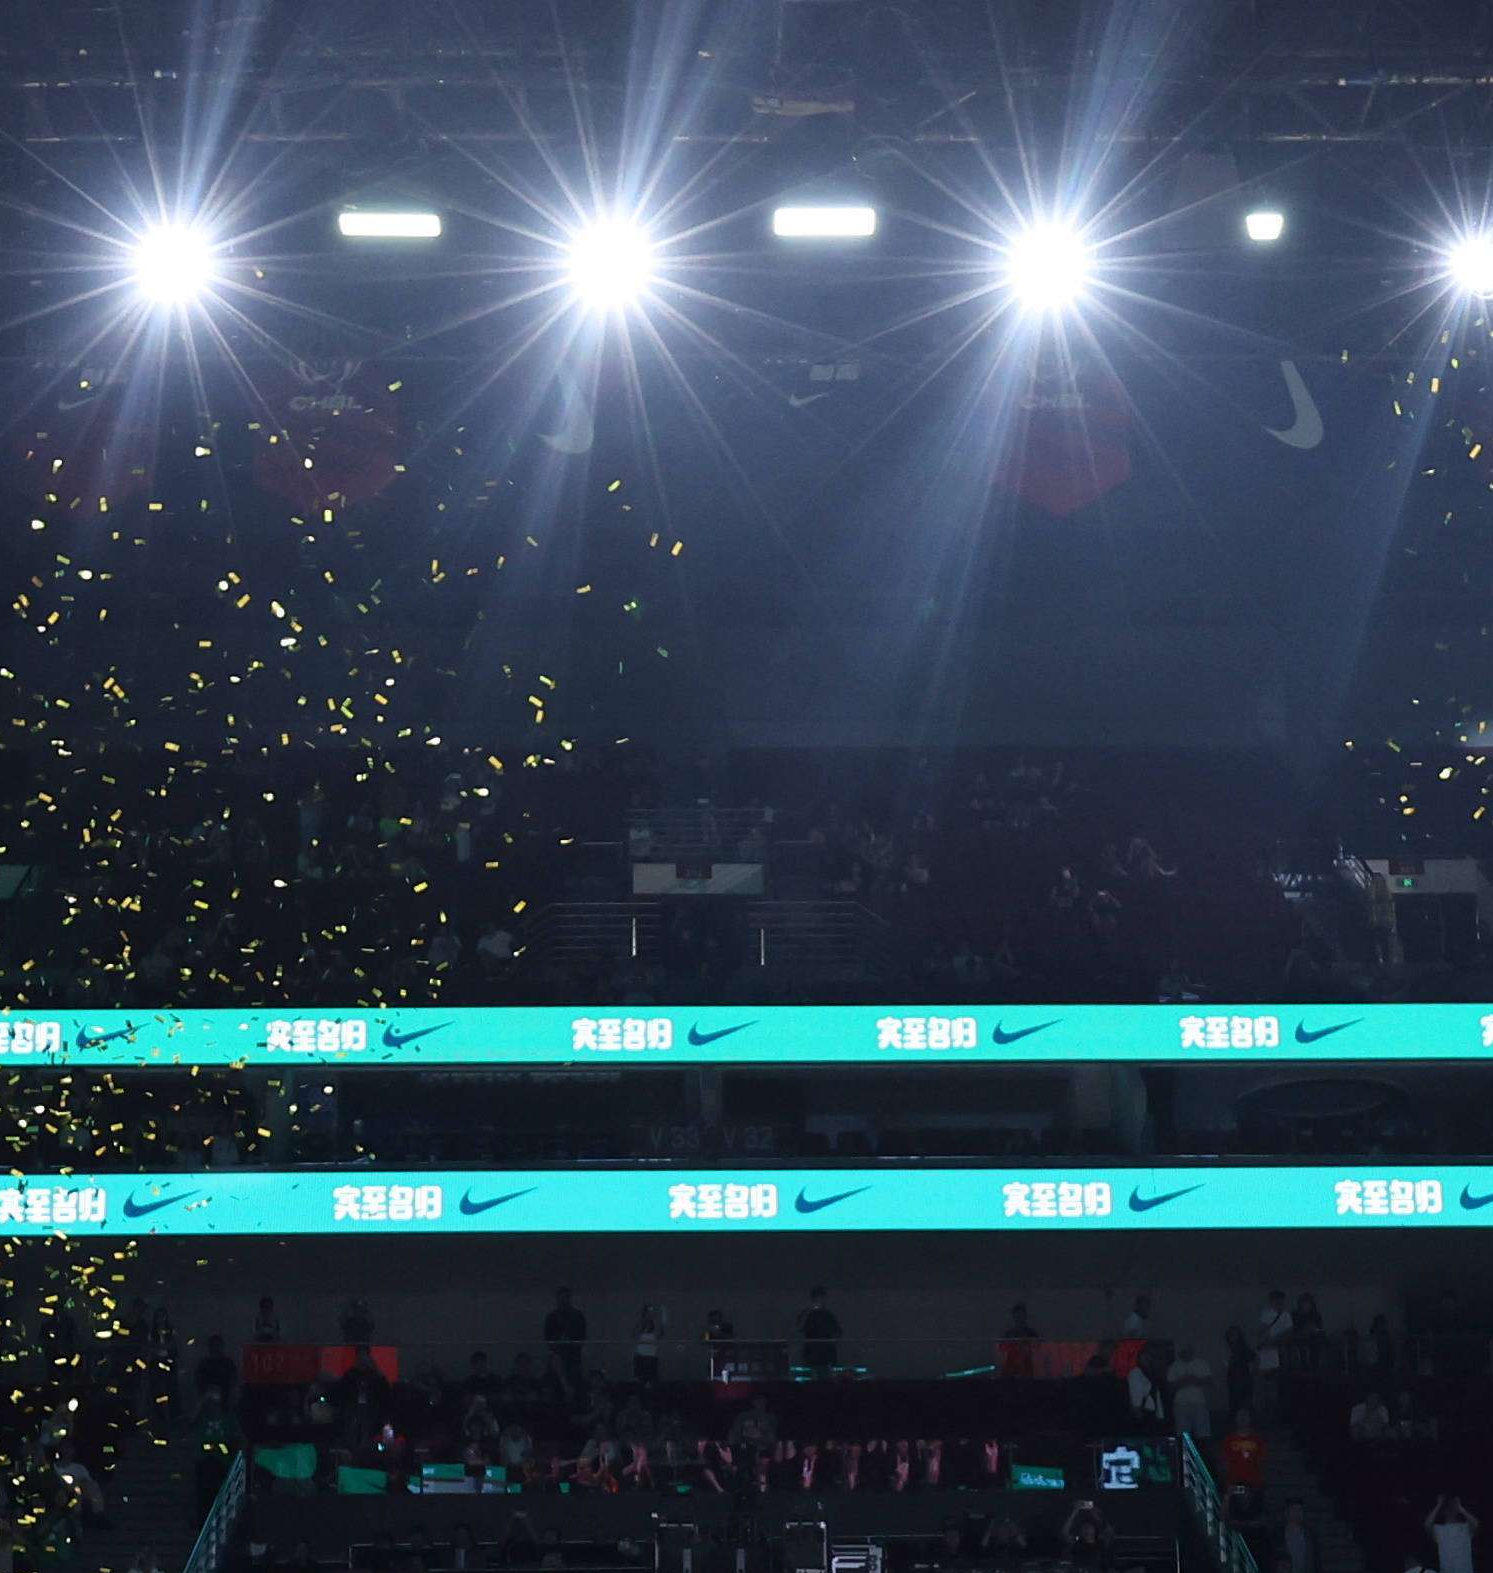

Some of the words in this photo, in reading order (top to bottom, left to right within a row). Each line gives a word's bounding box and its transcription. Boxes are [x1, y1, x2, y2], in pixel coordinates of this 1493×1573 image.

[572, 1017, 673, 1051] 实至名归
[876, 1016, 977, 1049] 实至名归
[1179, 1015, 1279, 1049] 实至名归
[333, 1184, 443, 1221] 实至名归
[668, 1183, 778, 1219] 实至名归
[1002, 1181, 1112, 1217] 实至名归
[1334, 1179, 1443, 1215] 实至名归
